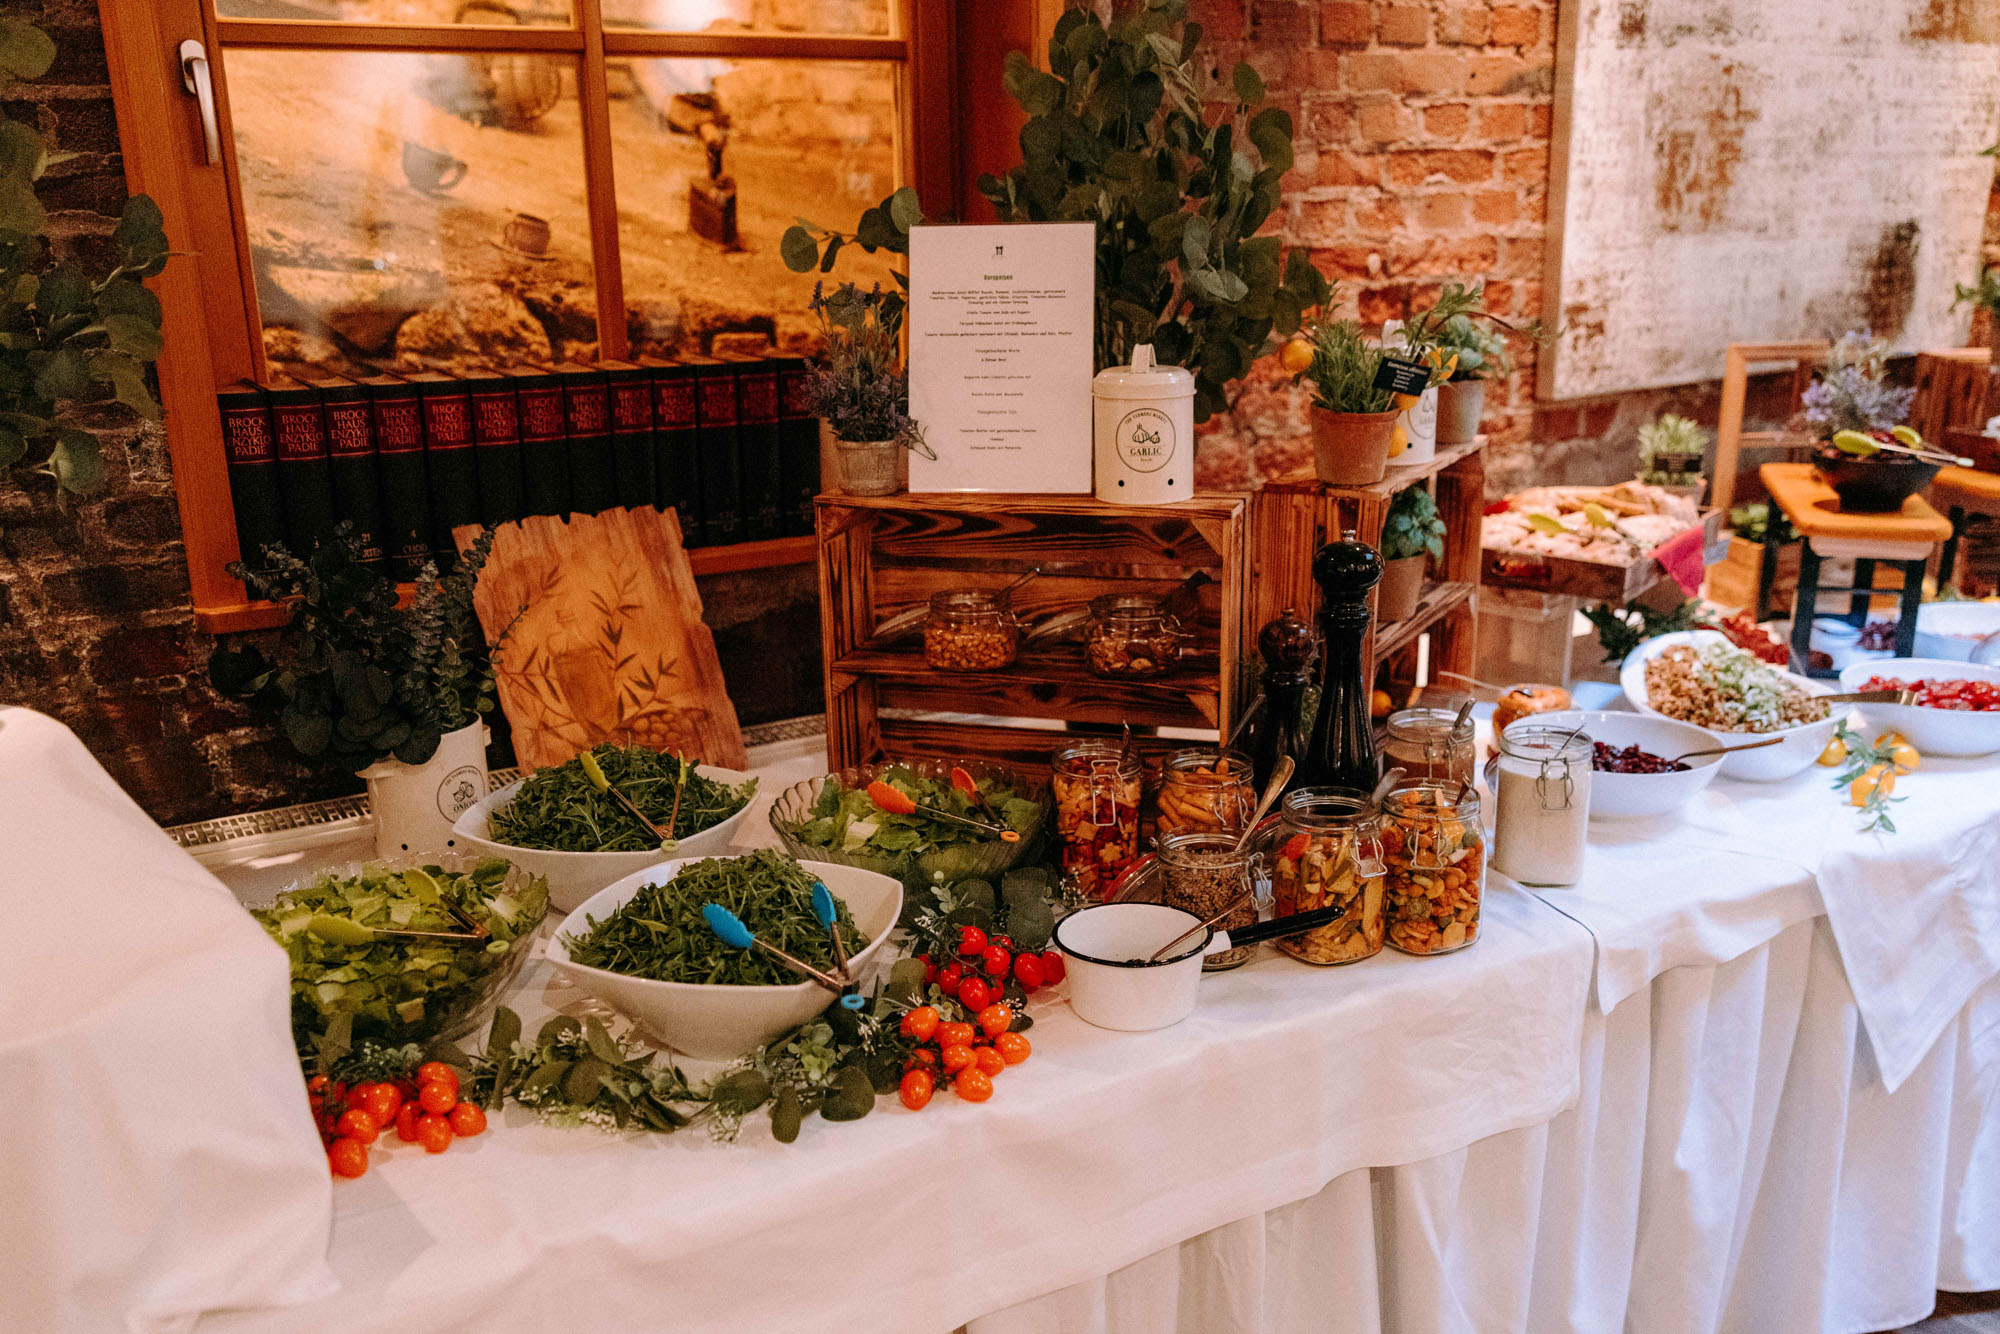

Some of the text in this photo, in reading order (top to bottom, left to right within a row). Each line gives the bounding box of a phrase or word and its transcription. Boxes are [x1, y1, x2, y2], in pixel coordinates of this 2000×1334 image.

[382, 406, 416, 418] BROCK
[432, 403, 465, 415] BROCK
[281, 413, 318, 425] BROCK
[333, 409, 368, 421] BROCK
[436, 413, 464, 423] HAUS
[229, 416, 265, 428] BROCK
[337, 419, 366, 430] HAUS
[387, 415, 415, 427] HAUS
[233, 426, 263, 437] HAUS
[286, 423, 316, 433] HAUS
[331, 427, 373, 440] ENZYKLO
[280, 432, 324, 443] ENZYKLO
[288, 442, 319, 453] PADIE
[340, 438, 369, 449] PADIE
[235, 446, 266, 457] PADIE
[1130, 447, 1161, 456] GARLIC
